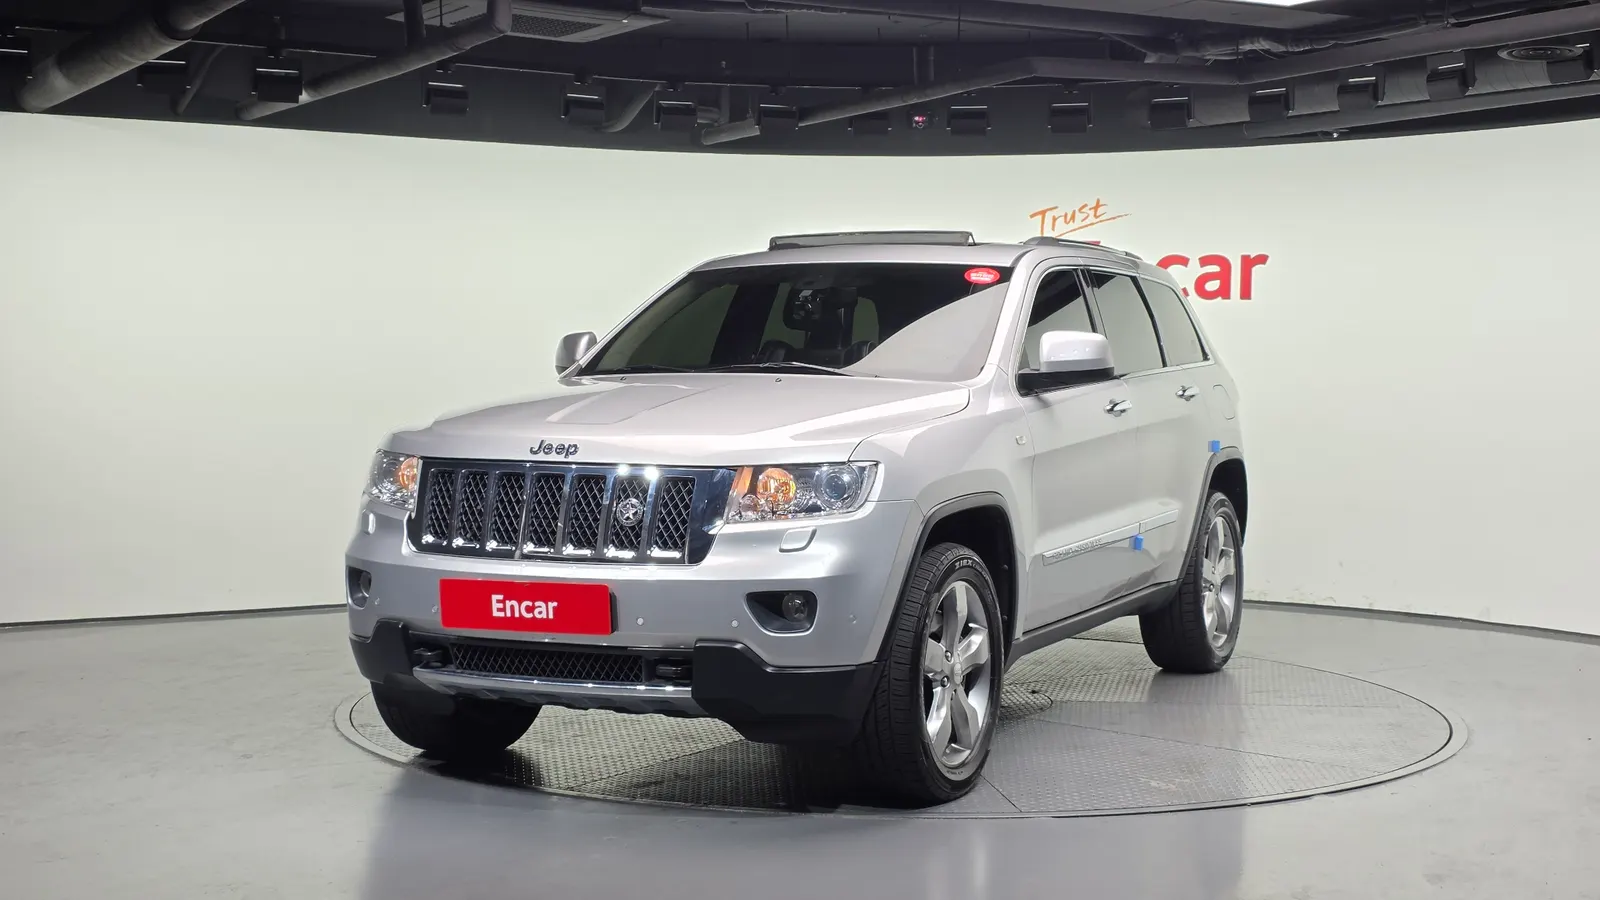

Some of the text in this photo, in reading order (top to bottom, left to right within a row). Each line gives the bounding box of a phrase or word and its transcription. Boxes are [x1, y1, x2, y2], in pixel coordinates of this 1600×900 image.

[1029, 198, 1108, 237] Trust
[529, 439, 580, 459] Jeep
[491, 594, 558, 619] Encar
